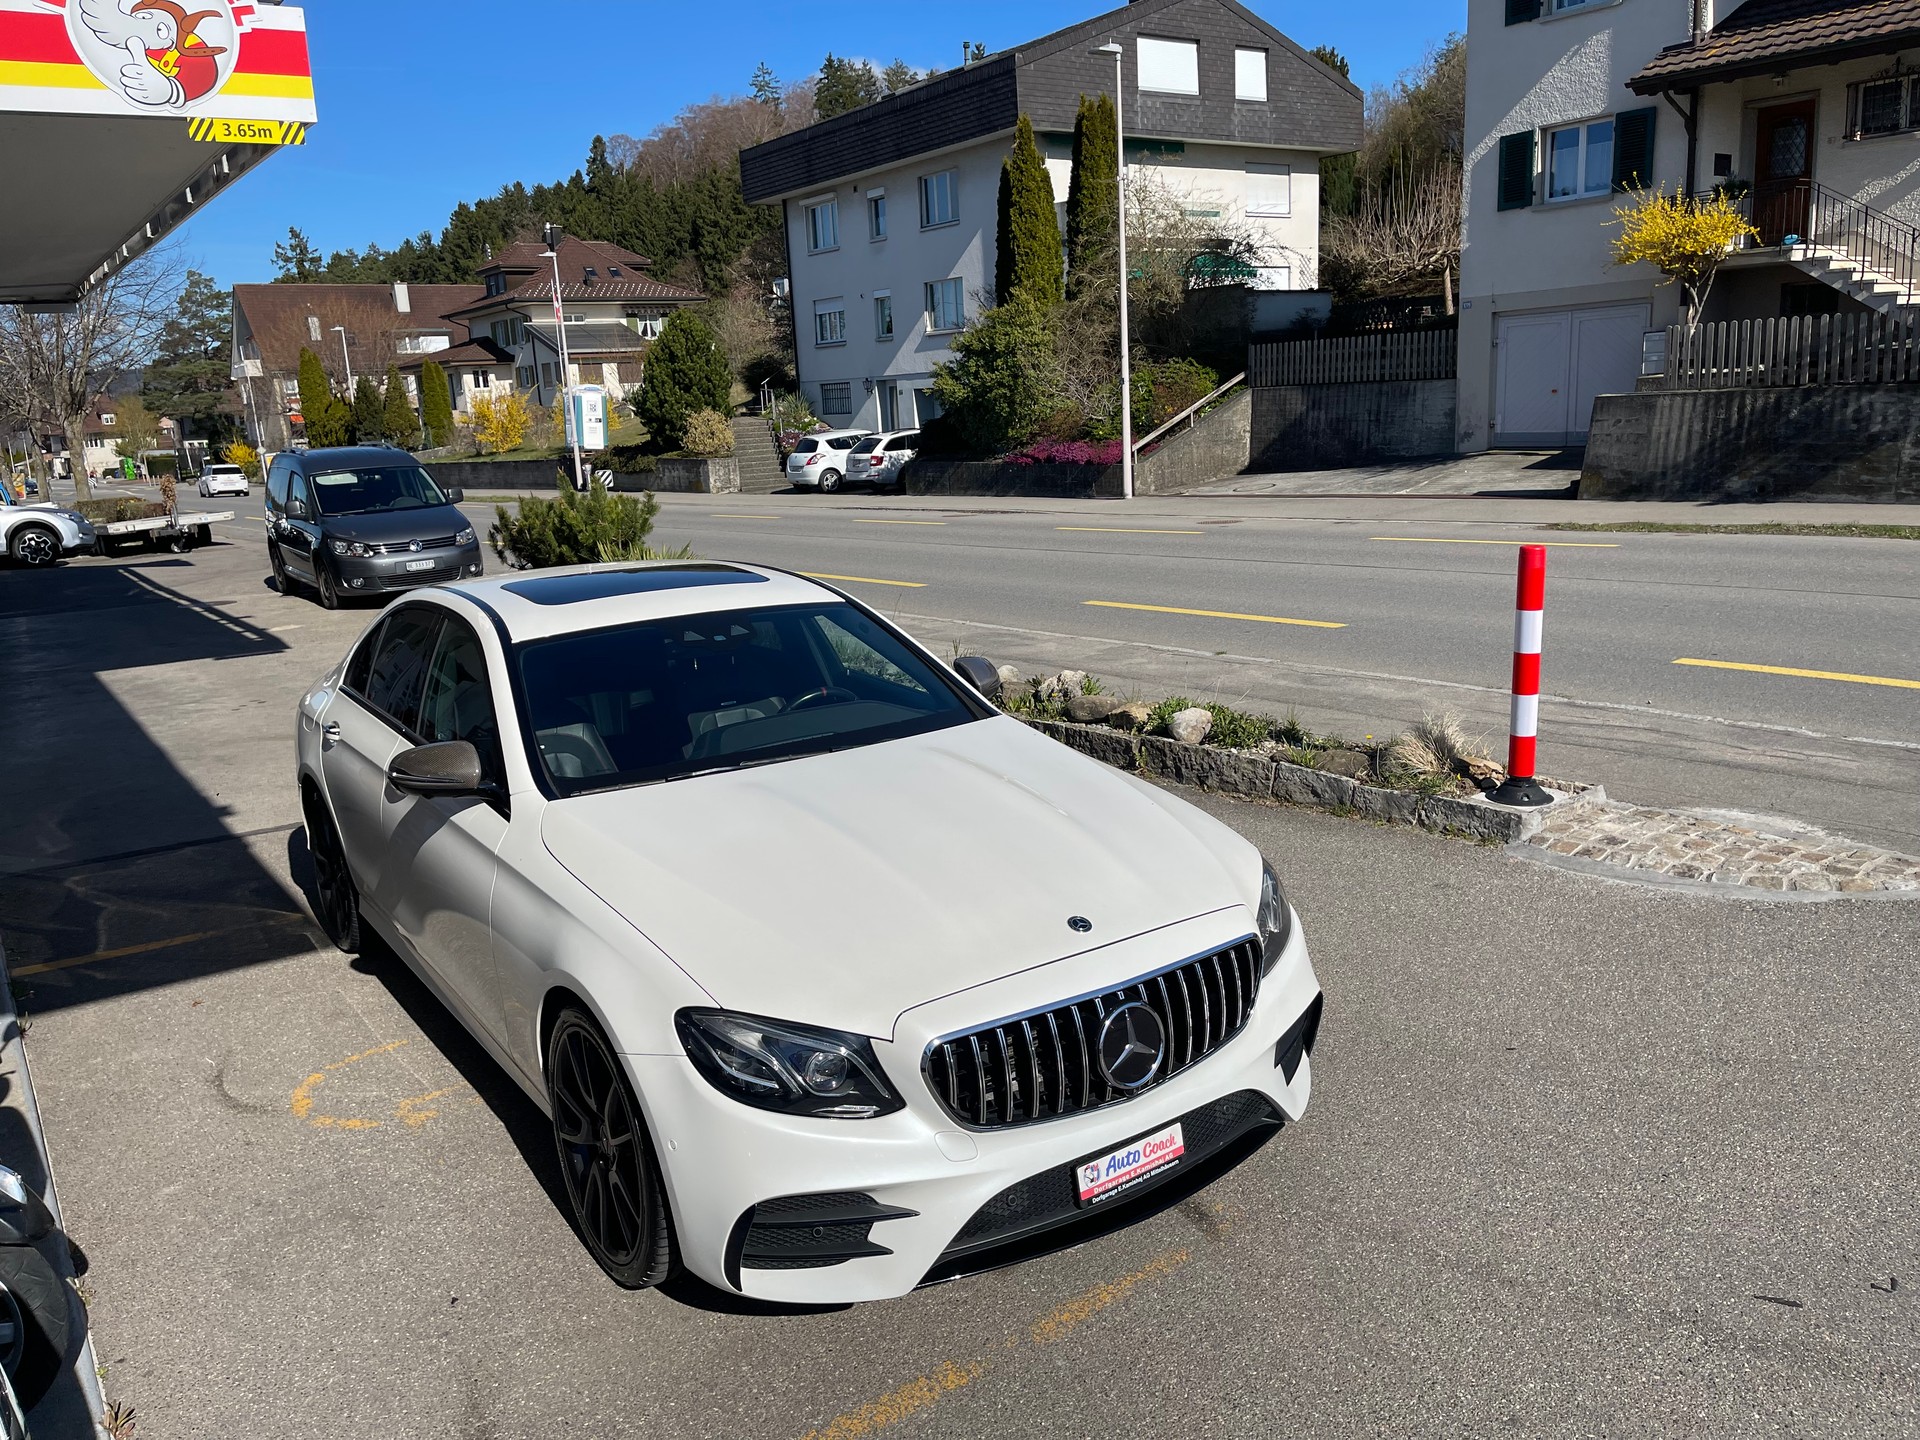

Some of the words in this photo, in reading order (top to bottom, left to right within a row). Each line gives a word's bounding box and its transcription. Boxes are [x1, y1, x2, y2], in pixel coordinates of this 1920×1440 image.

[221, 122, 273, 139] 3.65m
[1094, 1174, 1130, 1194] Dorfgarage
[1165, 1152, 1174, 1160] AG
[1106, 1150, 1141, 1177] Auto
[1143, 1133, 1177, 1158] Coach
[1092, 1188, 1118, 1204] Dorfgarage
[1143, 1171, 1151, 1179] AG
